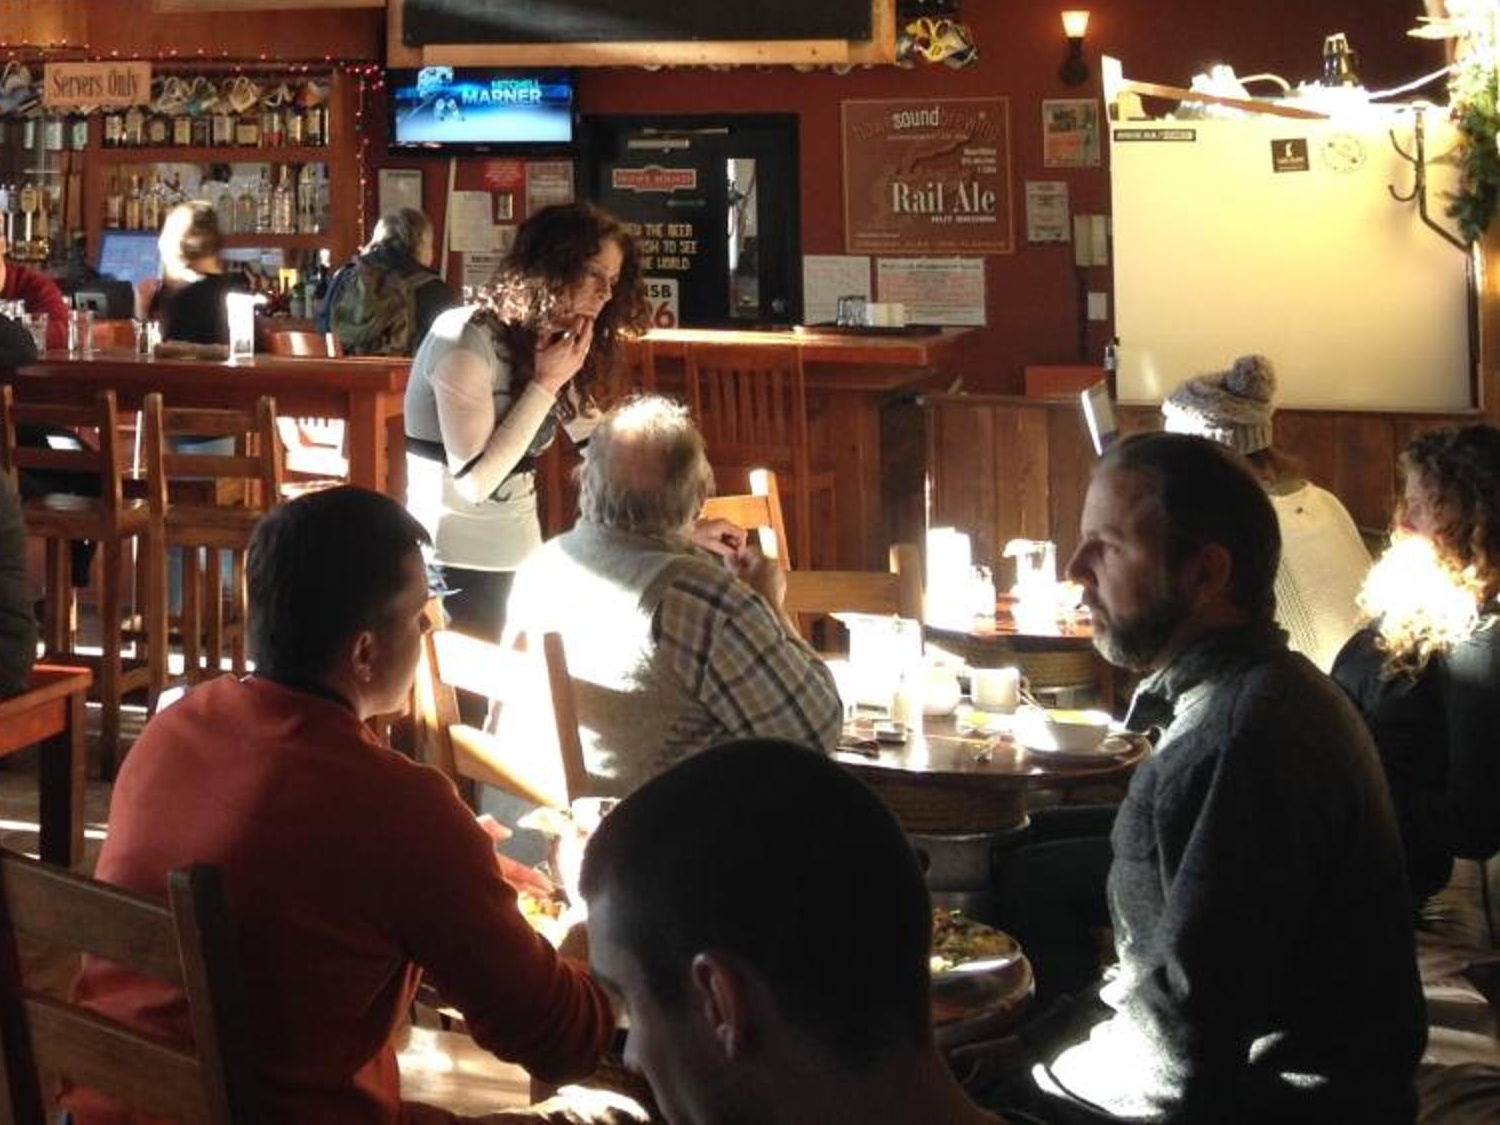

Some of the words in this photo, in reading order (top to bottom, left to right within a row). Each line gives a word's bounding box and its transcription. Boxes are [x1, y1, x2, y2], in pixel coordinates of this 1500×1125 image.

[53, 71, 101, 98] Servers
[106, 67, 137, 100] Only
[461, 88, 543, 104] MARNER
[891, 106, 940, 129] sound
[891, 180, 943, 214] Rail
[952, 180, 996, 214] Ale
[645, 224, 662, 237] THE
[667, 224, 693, 237] BEER
[662, 241, 677, 253] TO
[680, 241, 698, 254] SEE
[657, 257, 691, 270] WORLD
